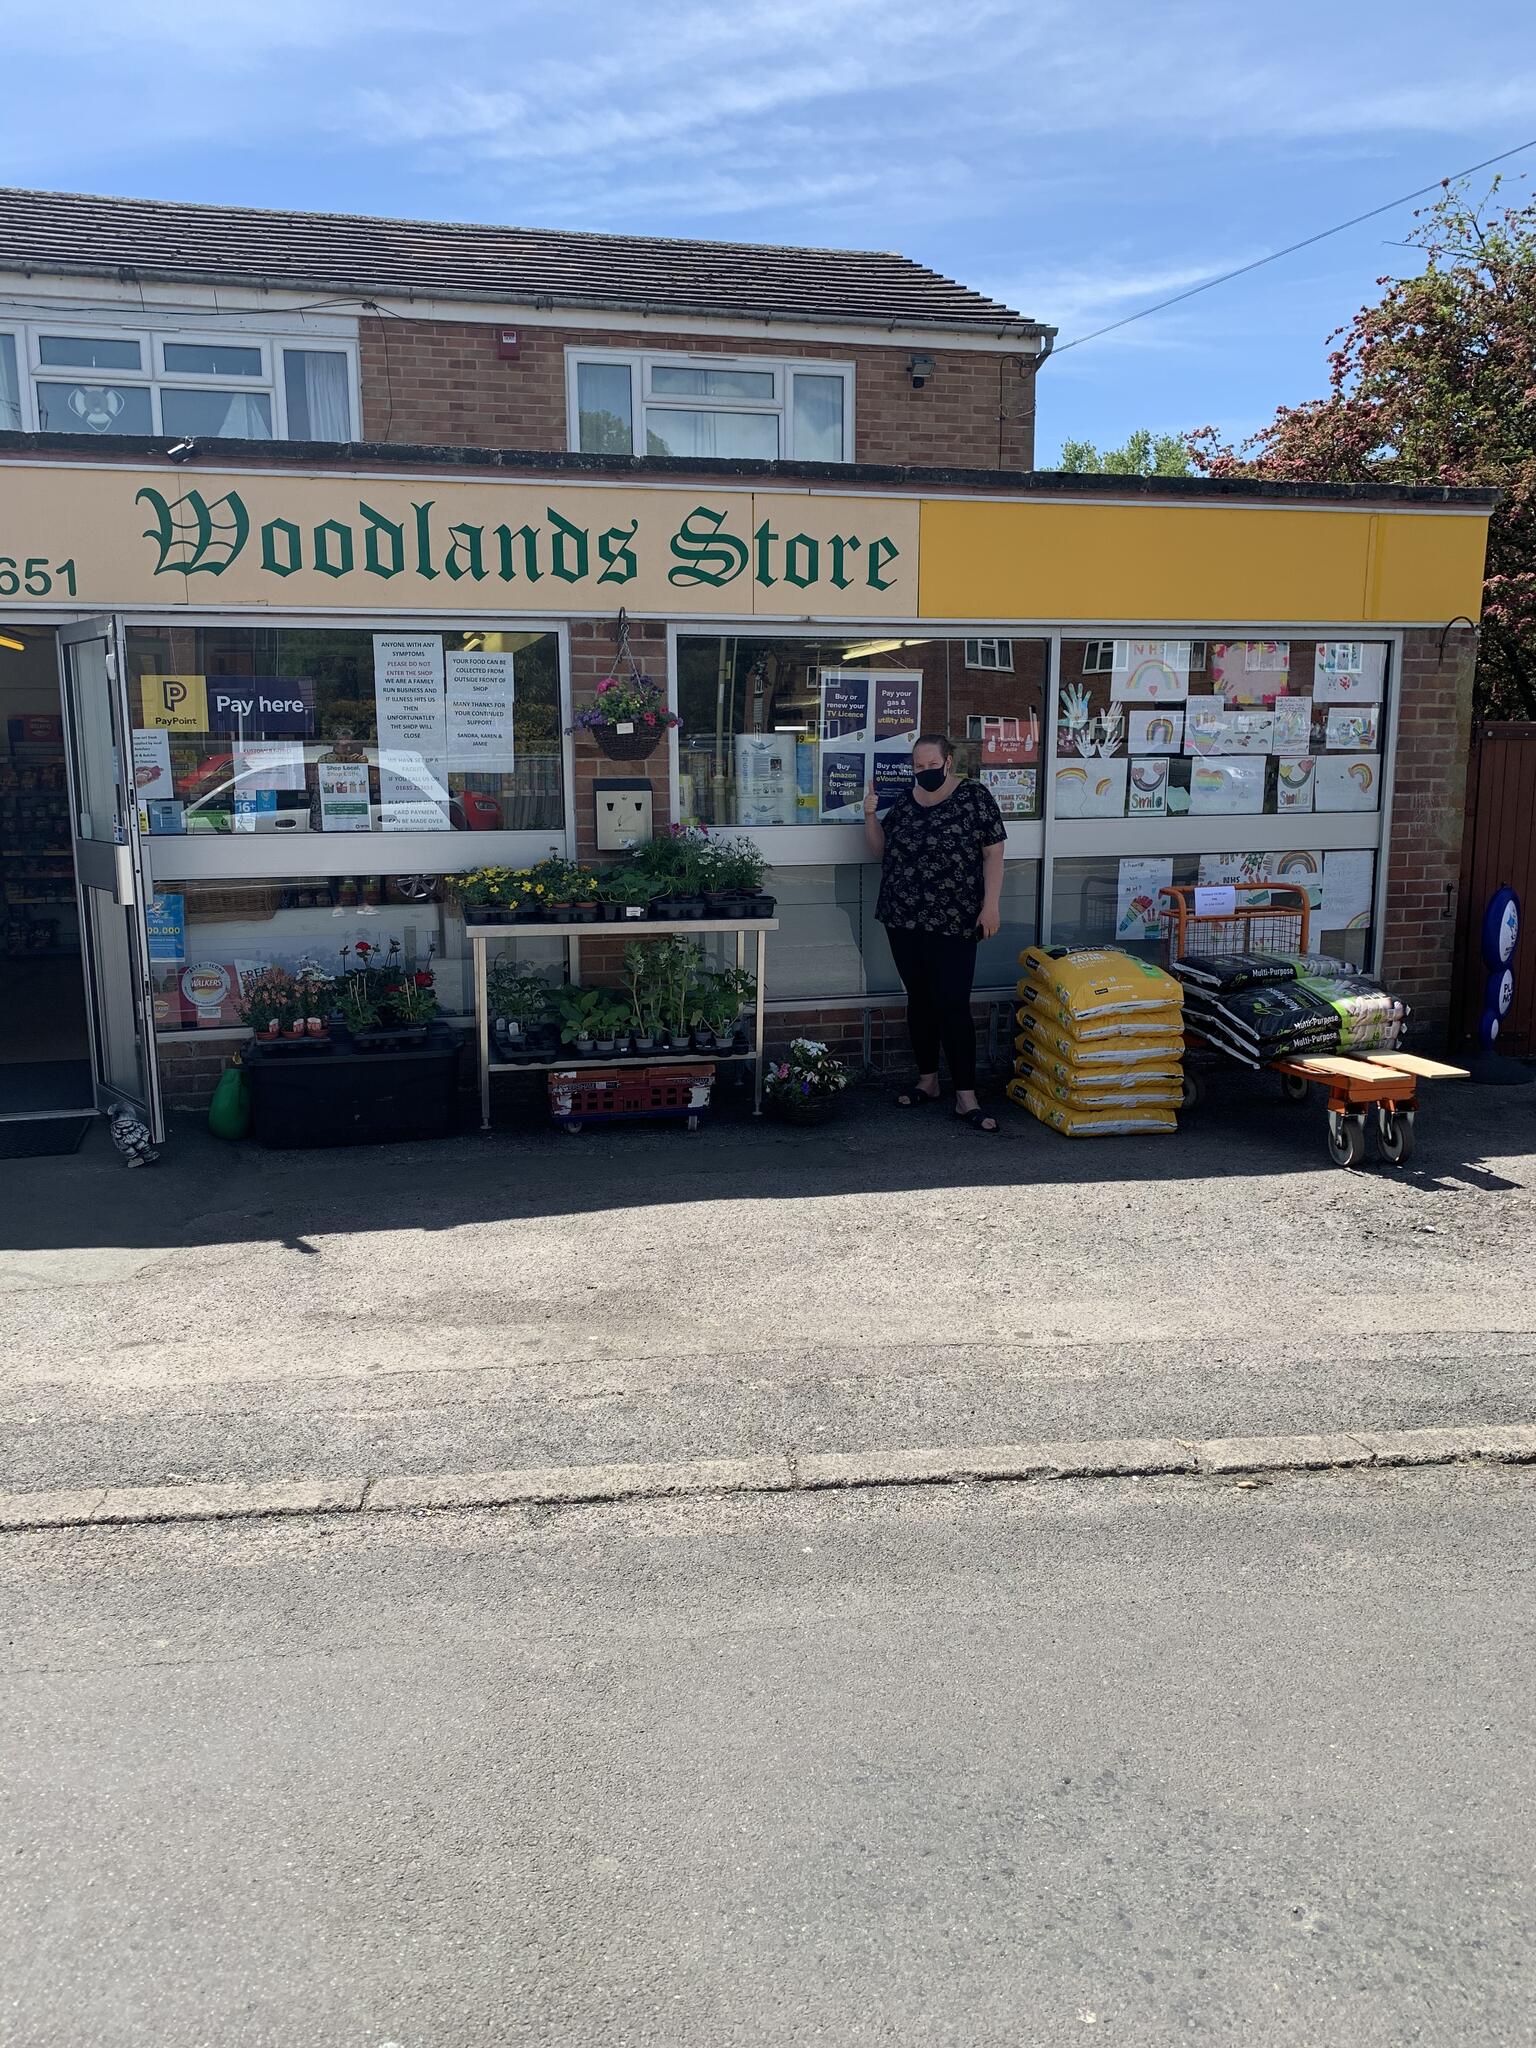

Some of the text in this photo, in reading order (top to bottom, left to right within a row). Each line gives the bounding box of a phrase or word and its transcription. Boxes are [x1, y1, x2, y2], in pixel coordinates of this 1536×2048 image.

[135, 487, 899, 591] Woodlands Store
[0, 558, 77, 597] 651
[882, 690, 894, 698] Pay
[216, 696, 304, 716] Pay here
[155, 717, 197, 727] PayPoint
[837, 763, 850, 771] Buy
[877, 762, 890, 770] Buy
[829, 780, 857, 788] top-ups
[1131, 792, 1163, 808] Smile
[1279, 791, 1308, 805] Smile
[238, 802, 256, 812] 16+
[1223, 876, 1241, 884] NHS
[239, 966, 268, 980] FREE
[1252, 968, 1294, 977] Multi-Purpose
[192, 979, 221, 987] WALKERS
[1293, 1015, 1339, 1030] Multi-Purpose
[1293, 1032, 1338, 1047] Multi-Purpose
